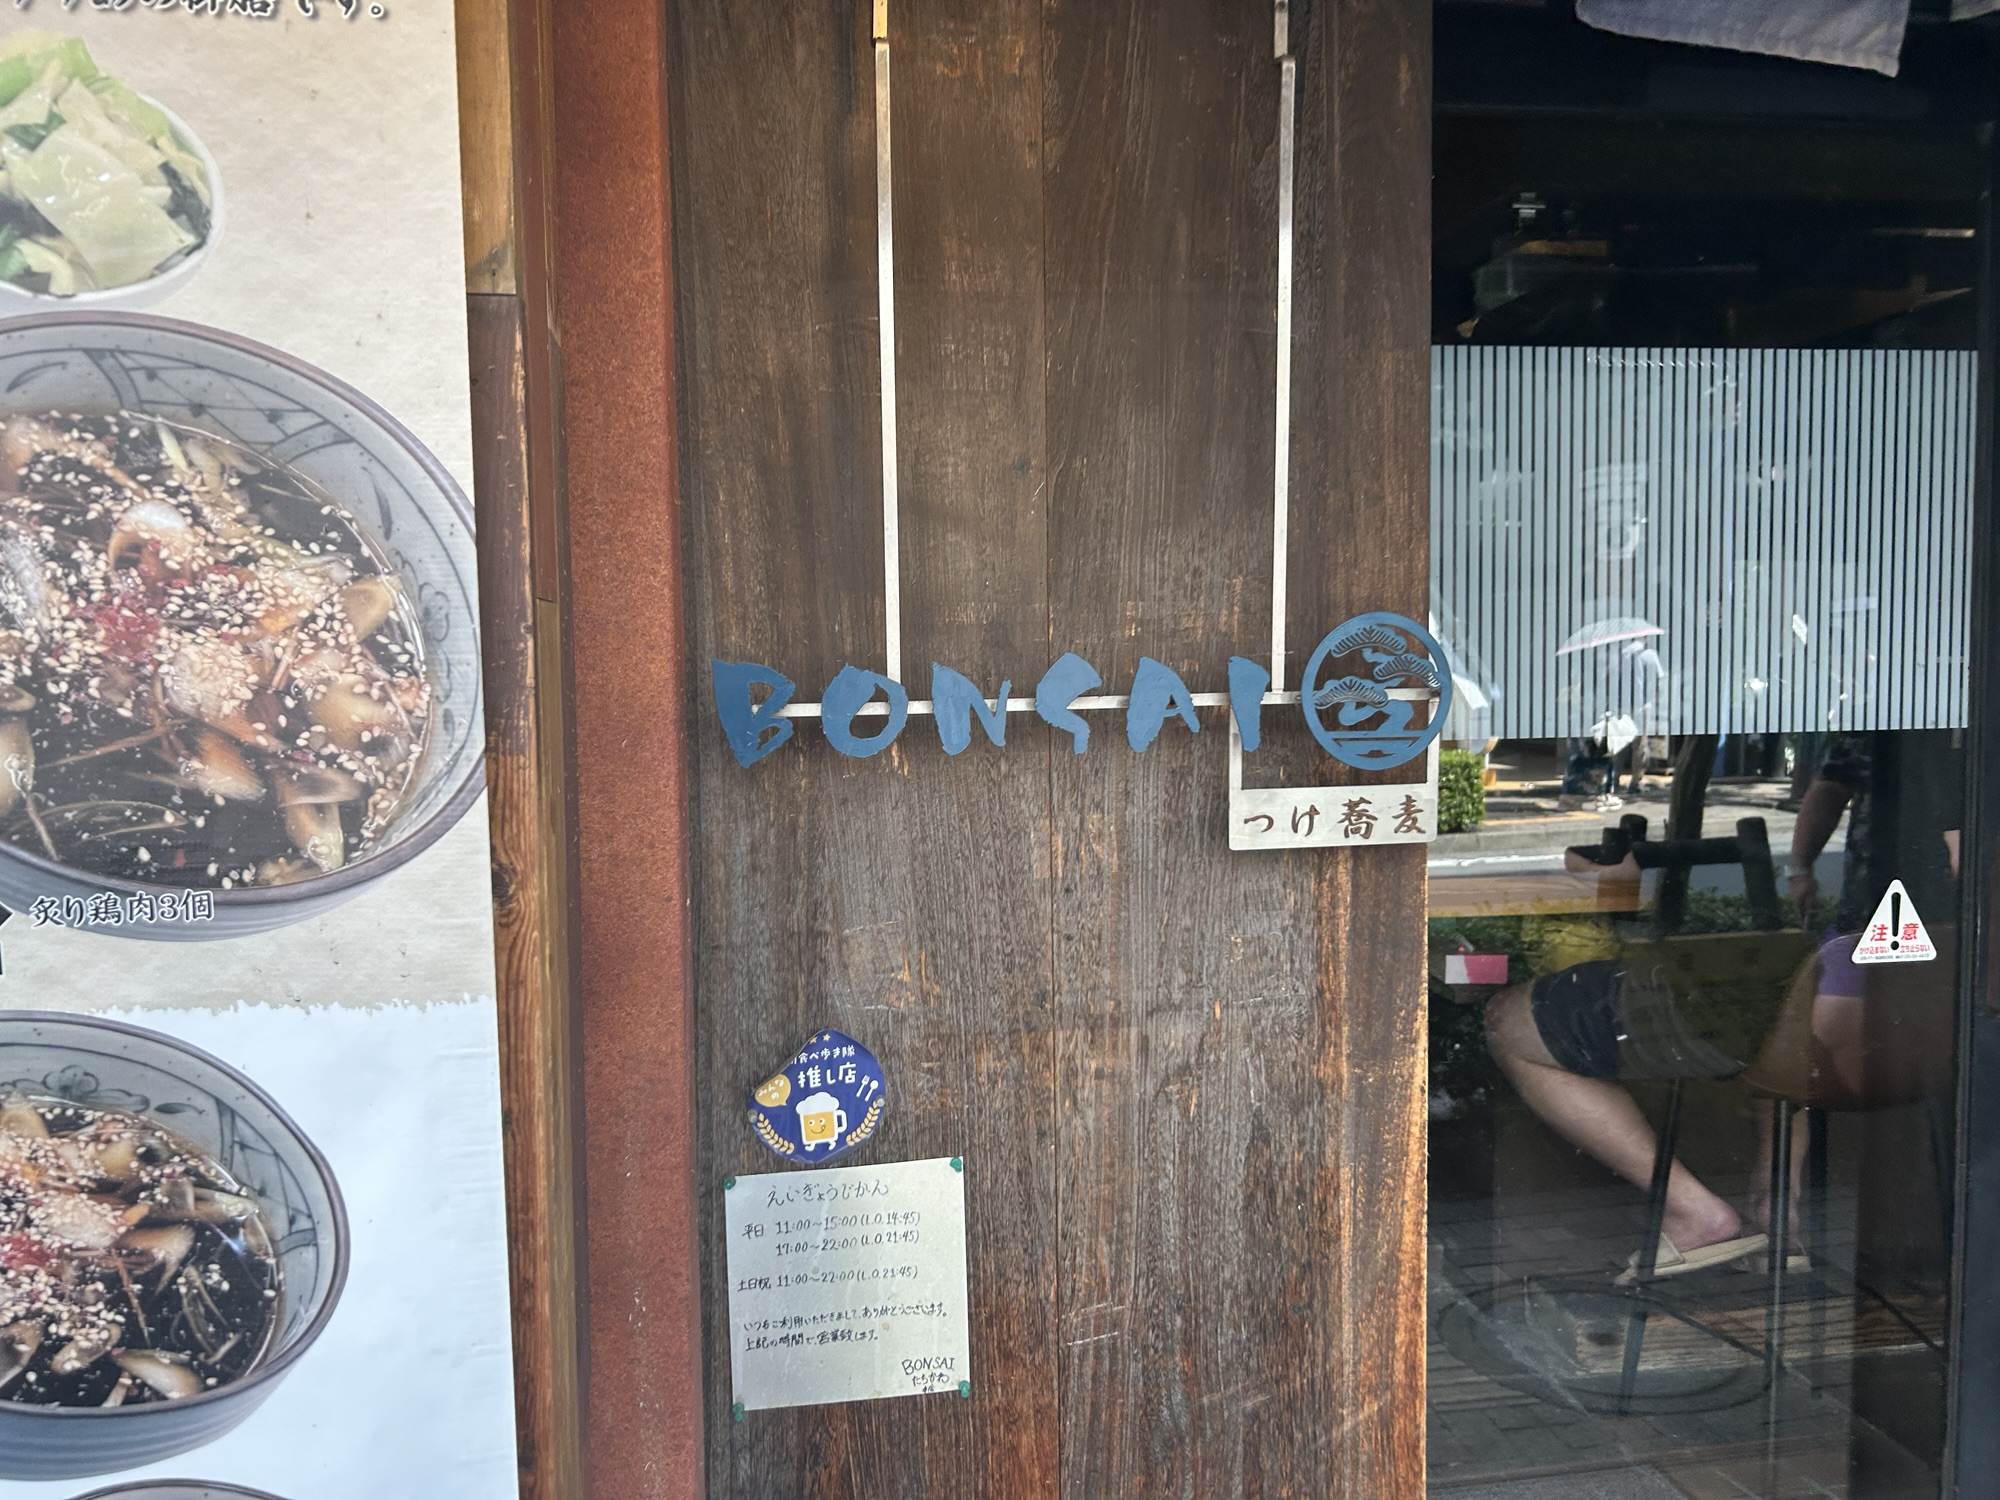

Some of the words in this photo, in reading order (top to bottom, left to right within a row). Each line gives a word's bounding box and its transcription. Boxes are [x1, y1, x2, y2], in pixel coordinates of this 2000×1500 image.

[712, 652, 1271, 768] BONSAI
[1243, 795, 1426, 840] つけ蕎麦
[29, 889, 215, 928] 炙り鶏肉3個
[797, 1061, 857, 1089] 推し店
[766, 1178, 889, 1209] えいぎょうじかん
[741, 1223, 765, 1240] 平日
[737, 1277, 772, 1292] 土日祝
[901, 1356, 956, 1376] BONSAI
